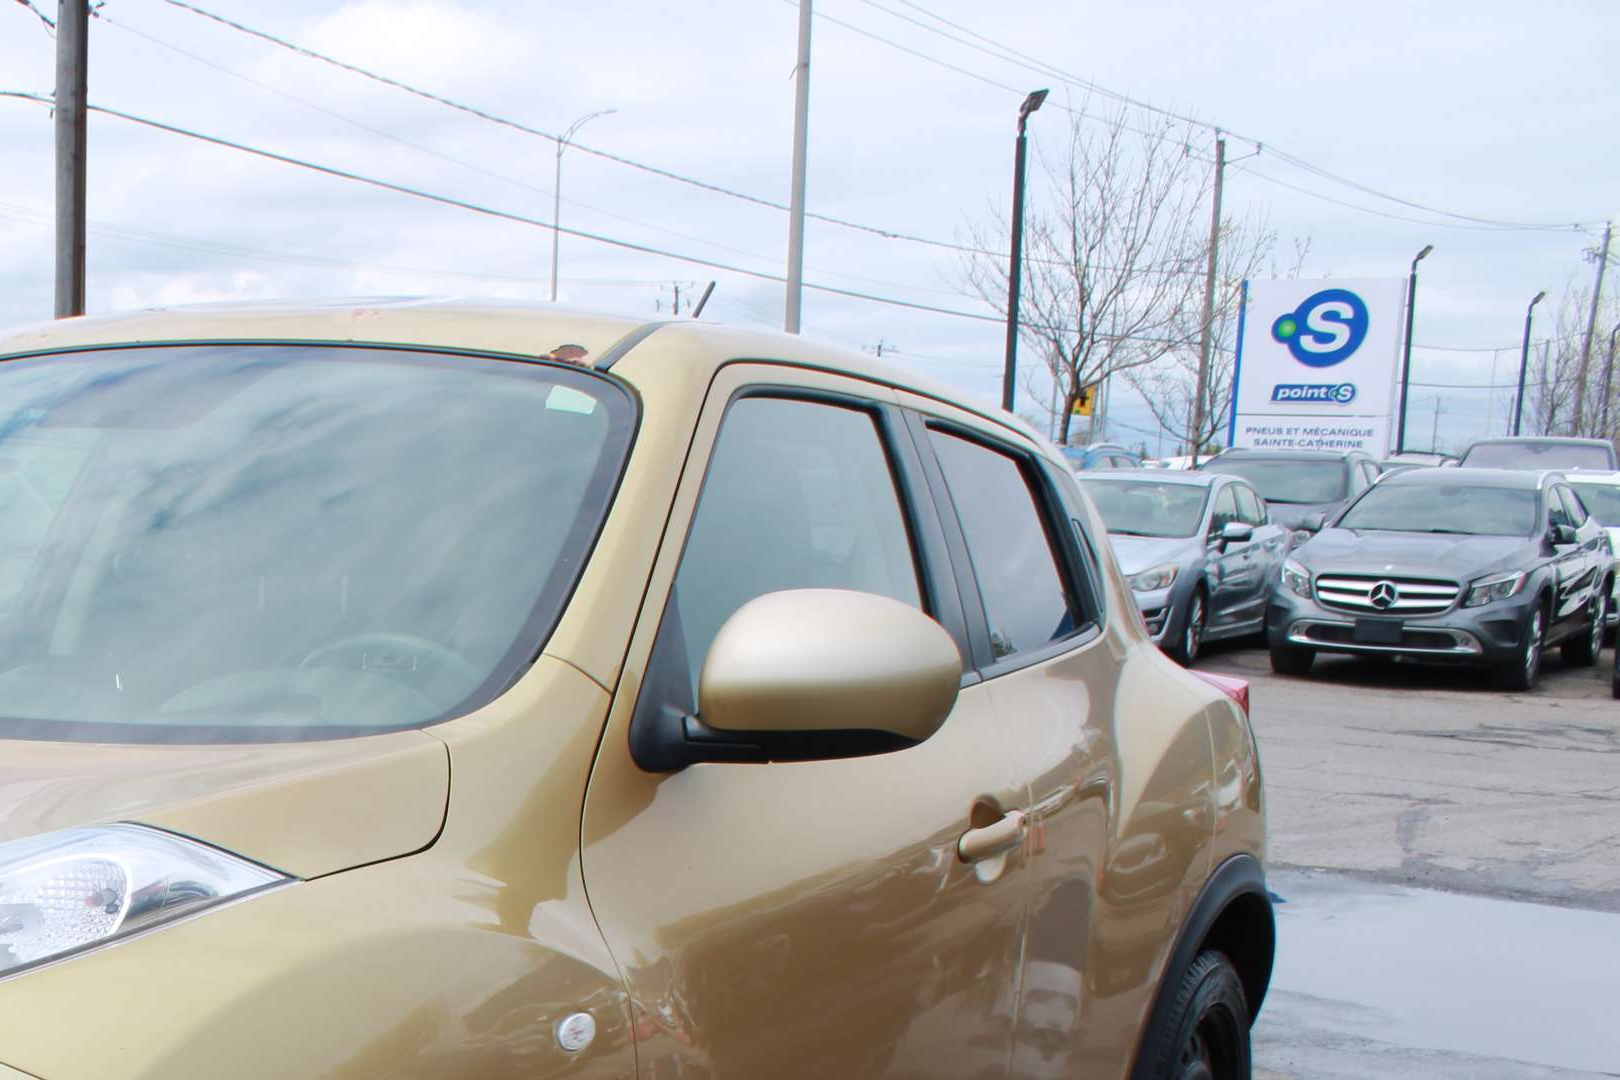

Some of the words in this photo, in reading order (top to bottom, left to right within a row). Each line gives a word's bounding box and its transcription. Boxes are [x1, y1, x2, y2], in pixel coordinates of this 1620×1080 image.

[1299, 301, 1355, 353] S
[1276, 386, 1328, 401] point
[1245, 426, 1283, 436] PNEUS
[1286, 427, 1301, 436] ET
[1303, 426, 1374, 438] MÉCANIQUE
[1253, 438, 1364, 449] SAINTE-CATHERINE
